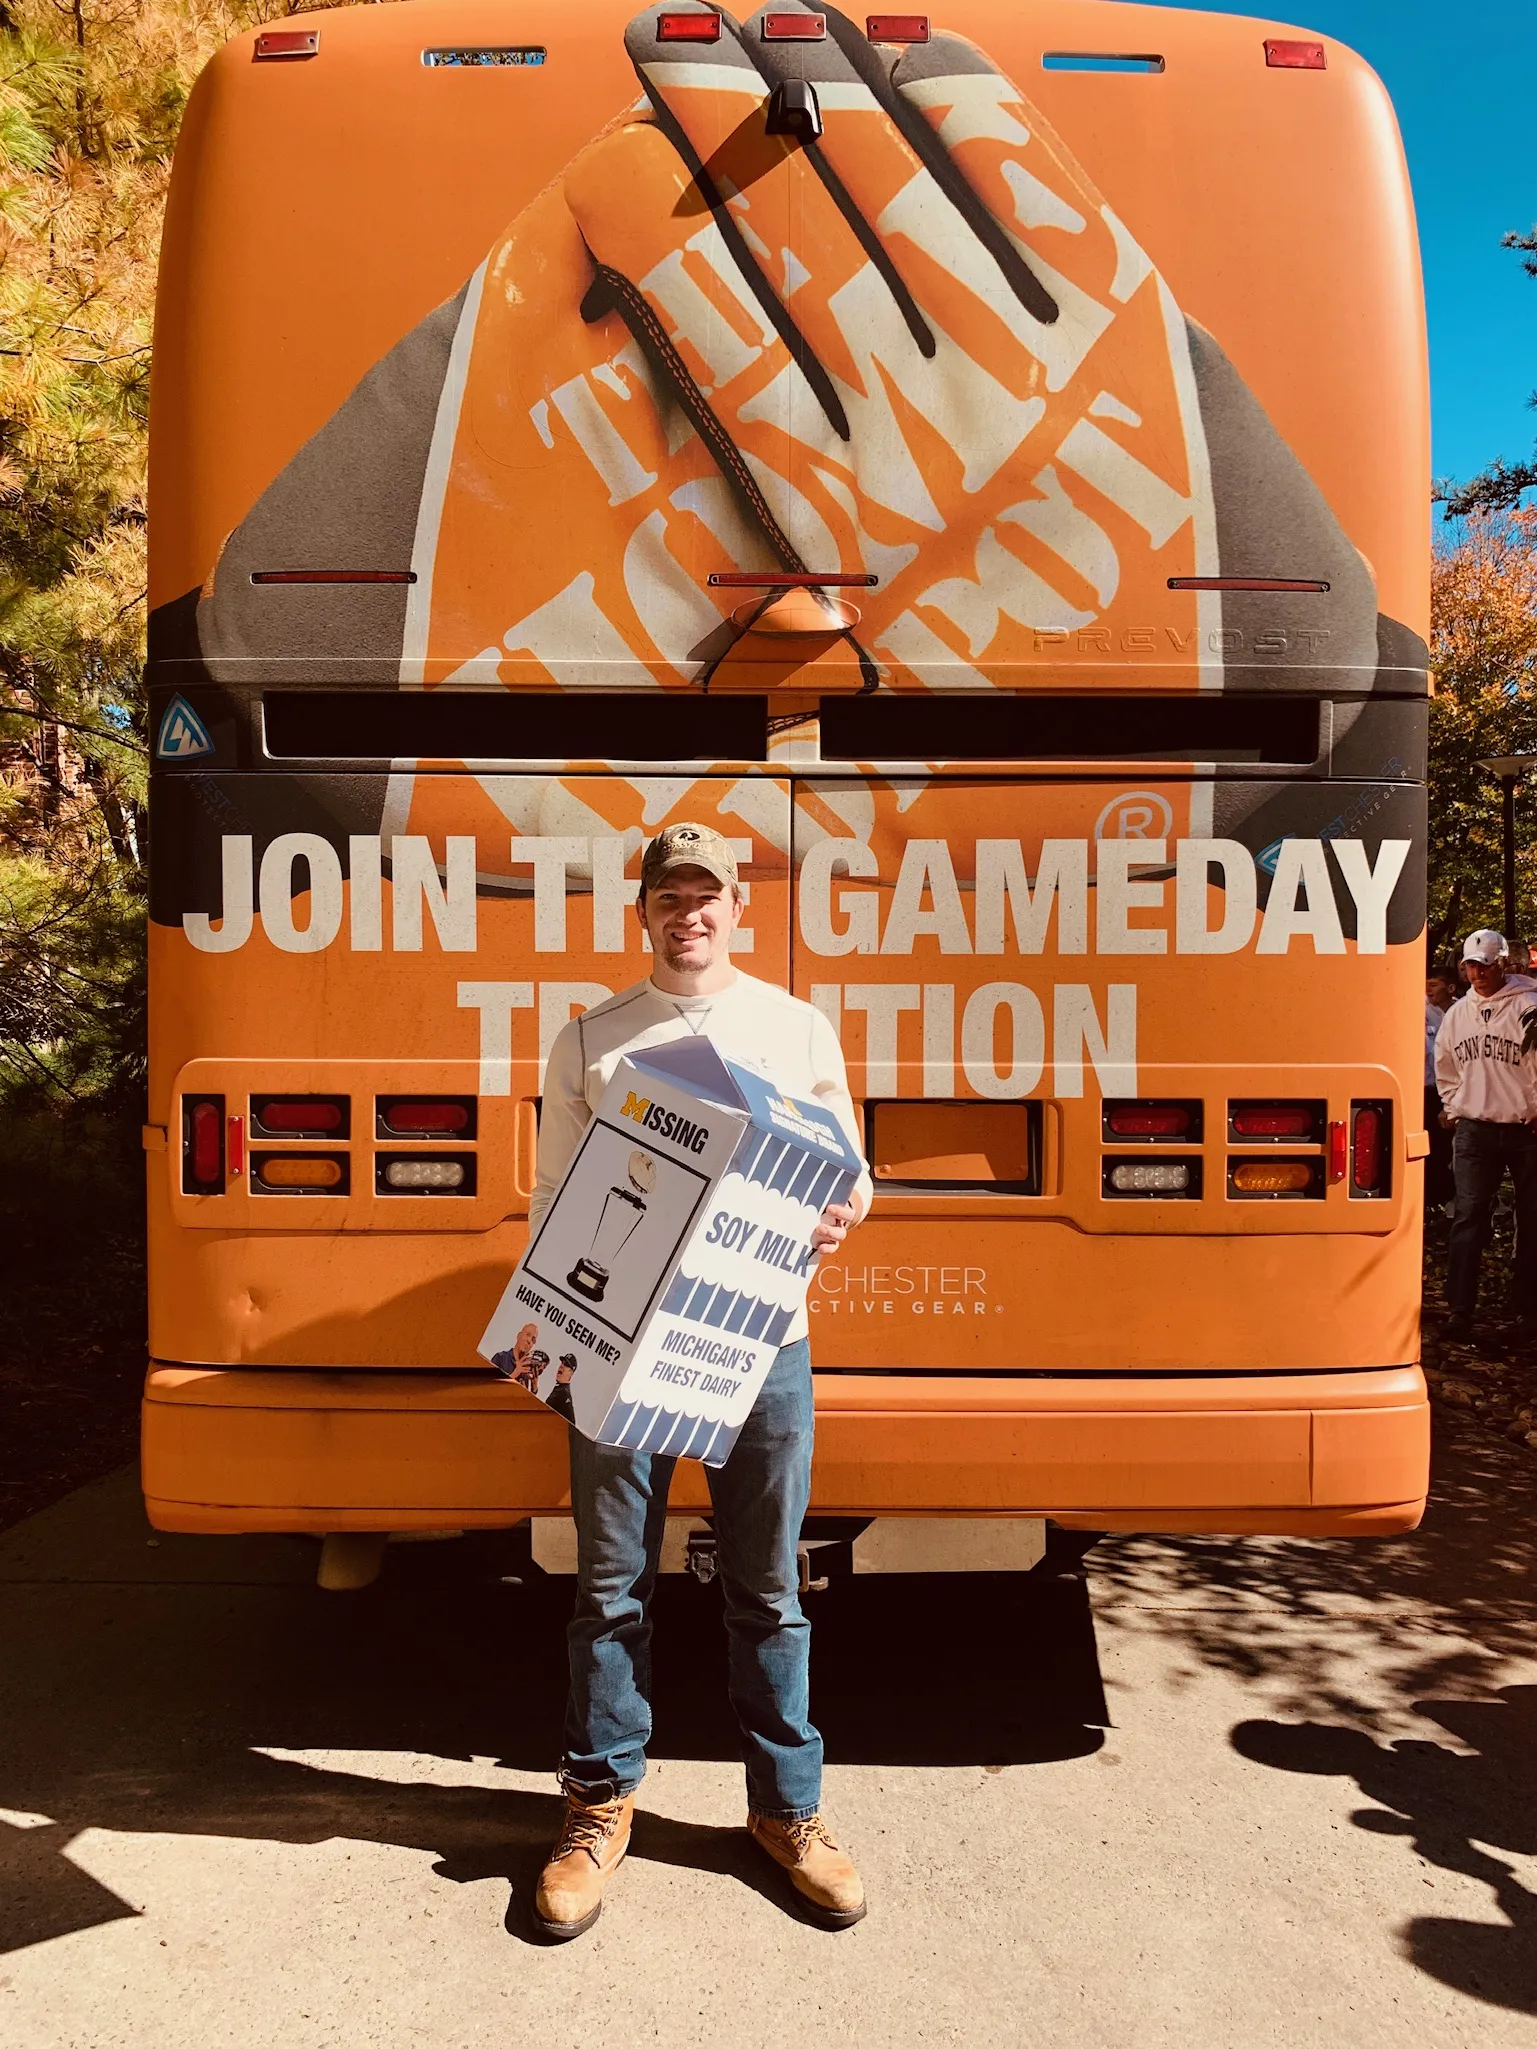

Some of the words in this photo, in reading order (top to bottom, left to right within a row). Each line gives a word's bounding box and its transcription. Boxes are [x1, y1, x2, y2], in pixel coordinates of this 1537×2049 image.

[1033, 626, 1330, 655] PREVOST
[1383, 769, 1408, 800] GER
[182, 833, 477, 953] JOIN
[799, 837, 1412, 957] GAMEDAY
[456, 981, 1138, 1099] TTION
[1484, 1034, 1521, 1066] STATE
[620, 1091, 709, 1155] MISSING
[705, 1211, 759, 1254] SOY
[753, 1228, 809, 1279] MILK
[818, 1265, 987, 1295] CHESTER
[515, 1284, 546, 1313] HAVE
[544, 1302, 567, 1327] YOU
[565, 1319, 597, 1349] SEEN
[595, 1339, 621, 1366] ME?
[809, 1300, 894, 1314] CTIVE
[661, 1329, 756, 1373] MICHIGAN'S
[649, 1360, 702, 1388] FINEST
[699, 1373, 742, 1399] DAIRY
